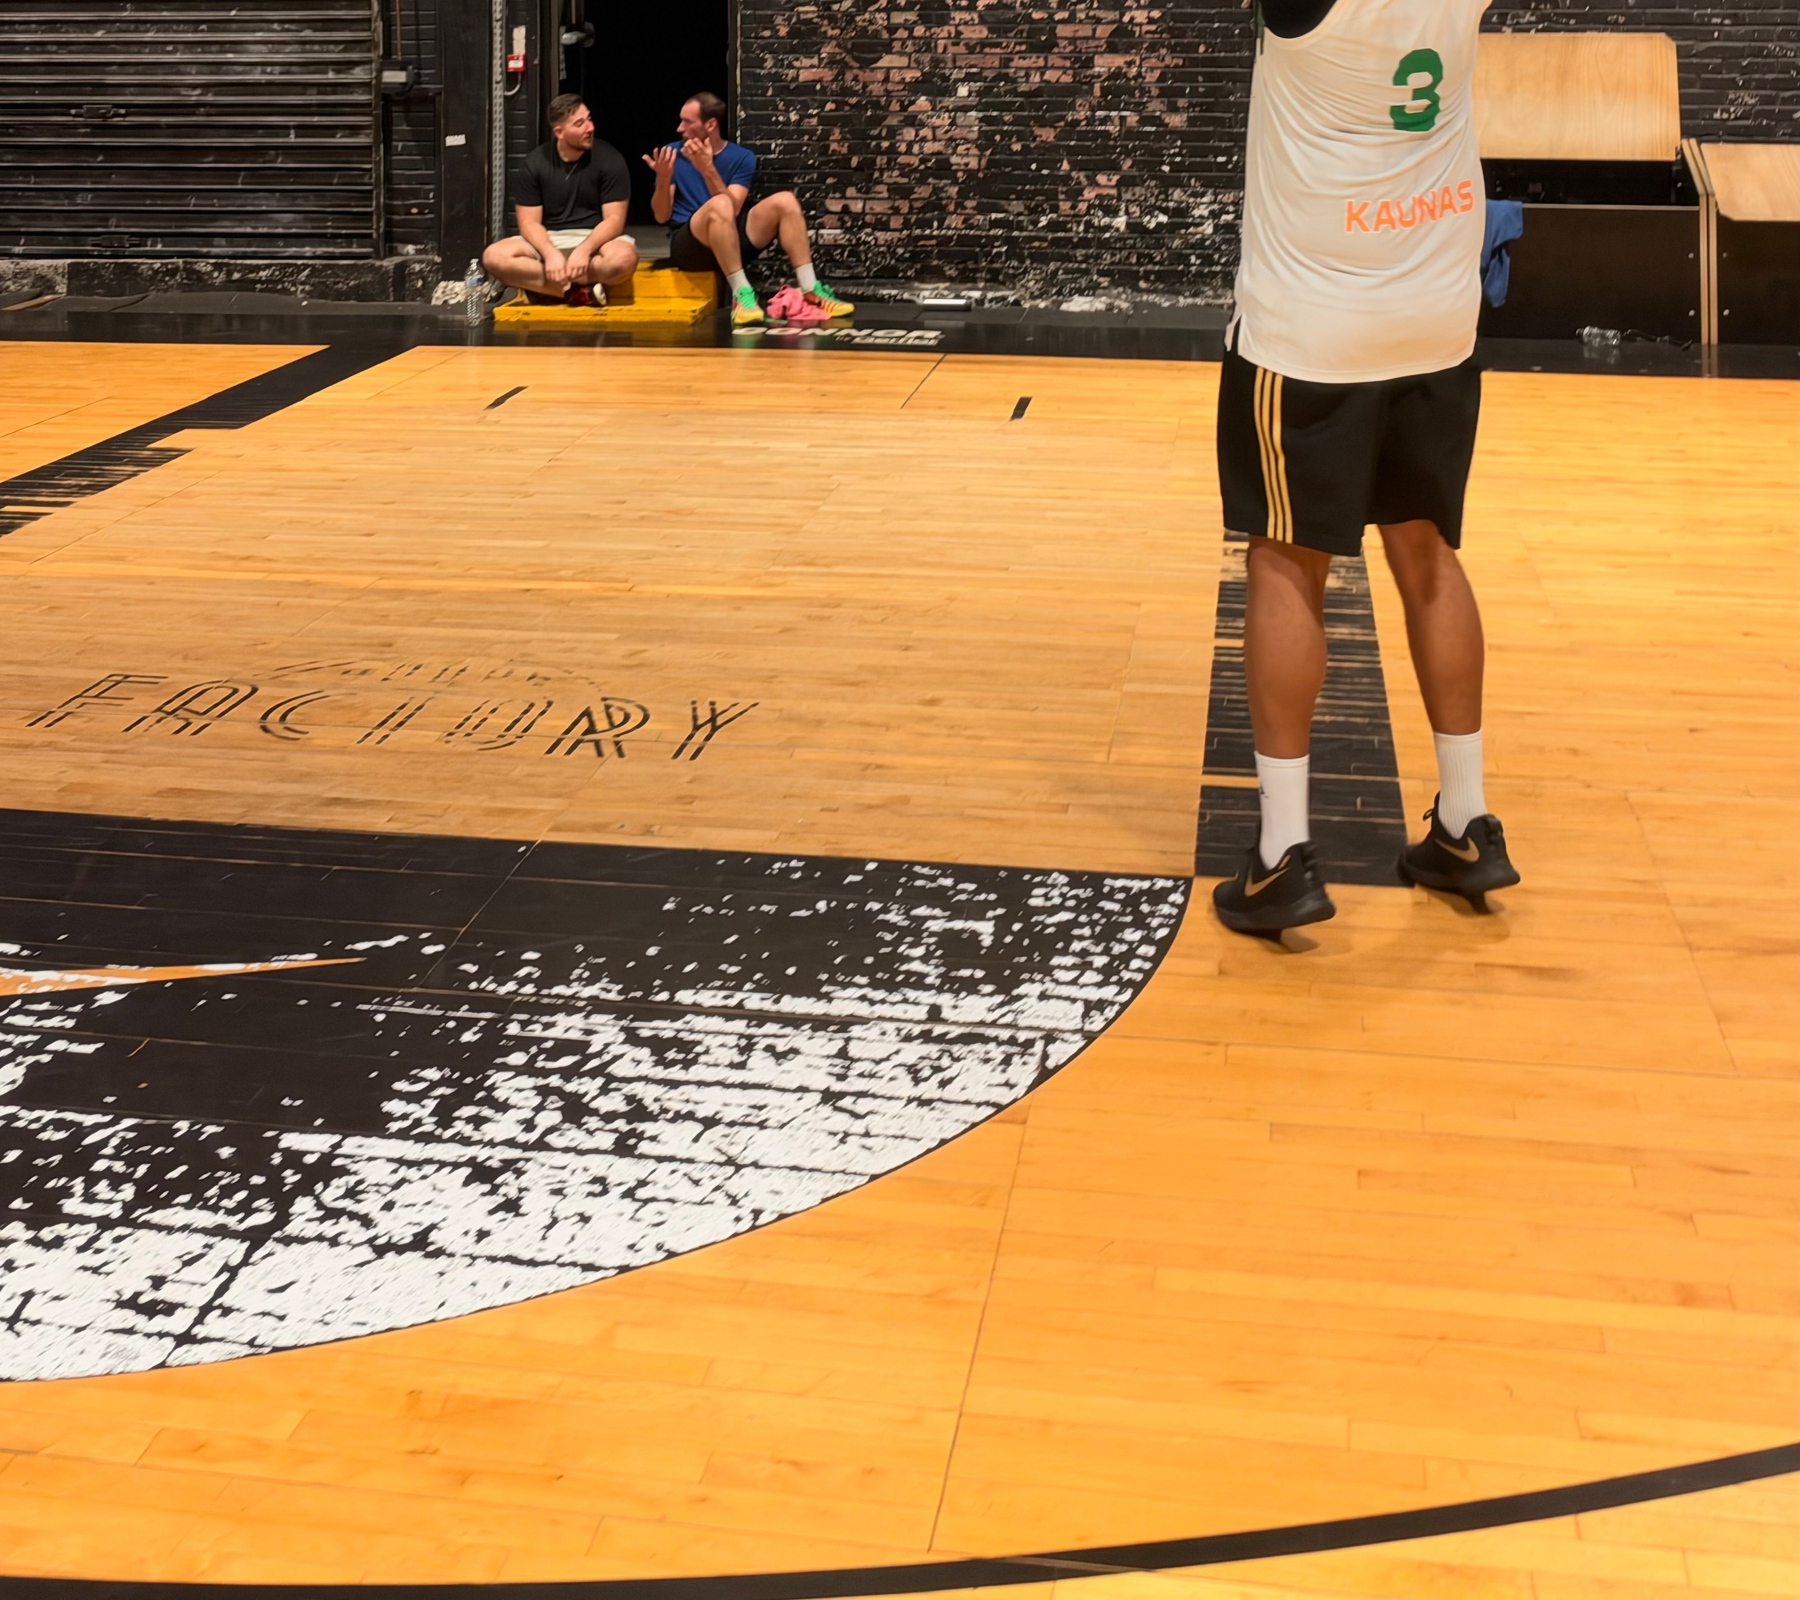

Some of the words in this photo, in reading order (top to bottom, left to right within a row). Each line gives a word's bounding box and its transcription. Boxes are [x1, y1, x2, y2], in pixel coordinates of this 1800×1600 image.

[1389, 48, 1444, 132] 3
[1345, 180, 1475, 233] KAUNAS
[732, 327, 942, 339] CONNOR
